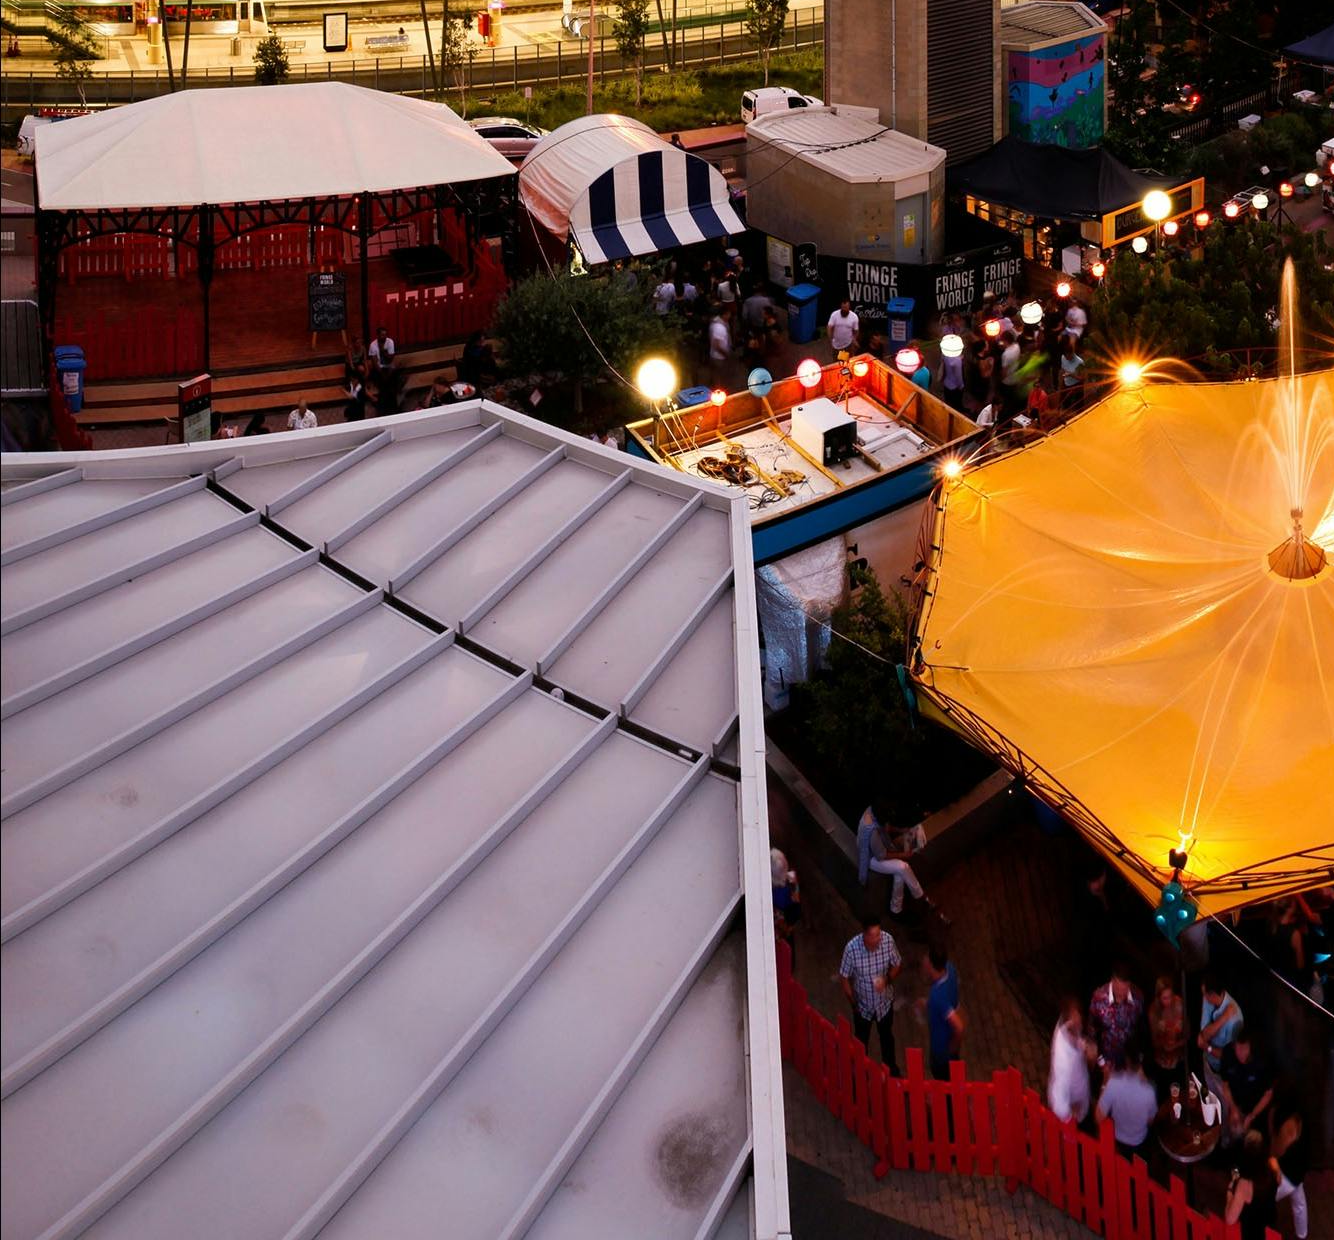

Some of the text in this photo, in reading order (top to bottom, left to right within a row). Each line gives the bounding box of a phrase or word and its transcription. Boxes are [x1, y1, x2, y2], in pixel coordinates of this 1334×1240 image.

[847, 262, 898, 287] FRINGE
[984, 258, 1021, 281] FRINGE
[848, 282, 899, 304] WORLD
[935, 270, 975, 294] FRINGE
[984, 277, 1013, 297] WORL
[936, 287, 975, 311] WORLD
